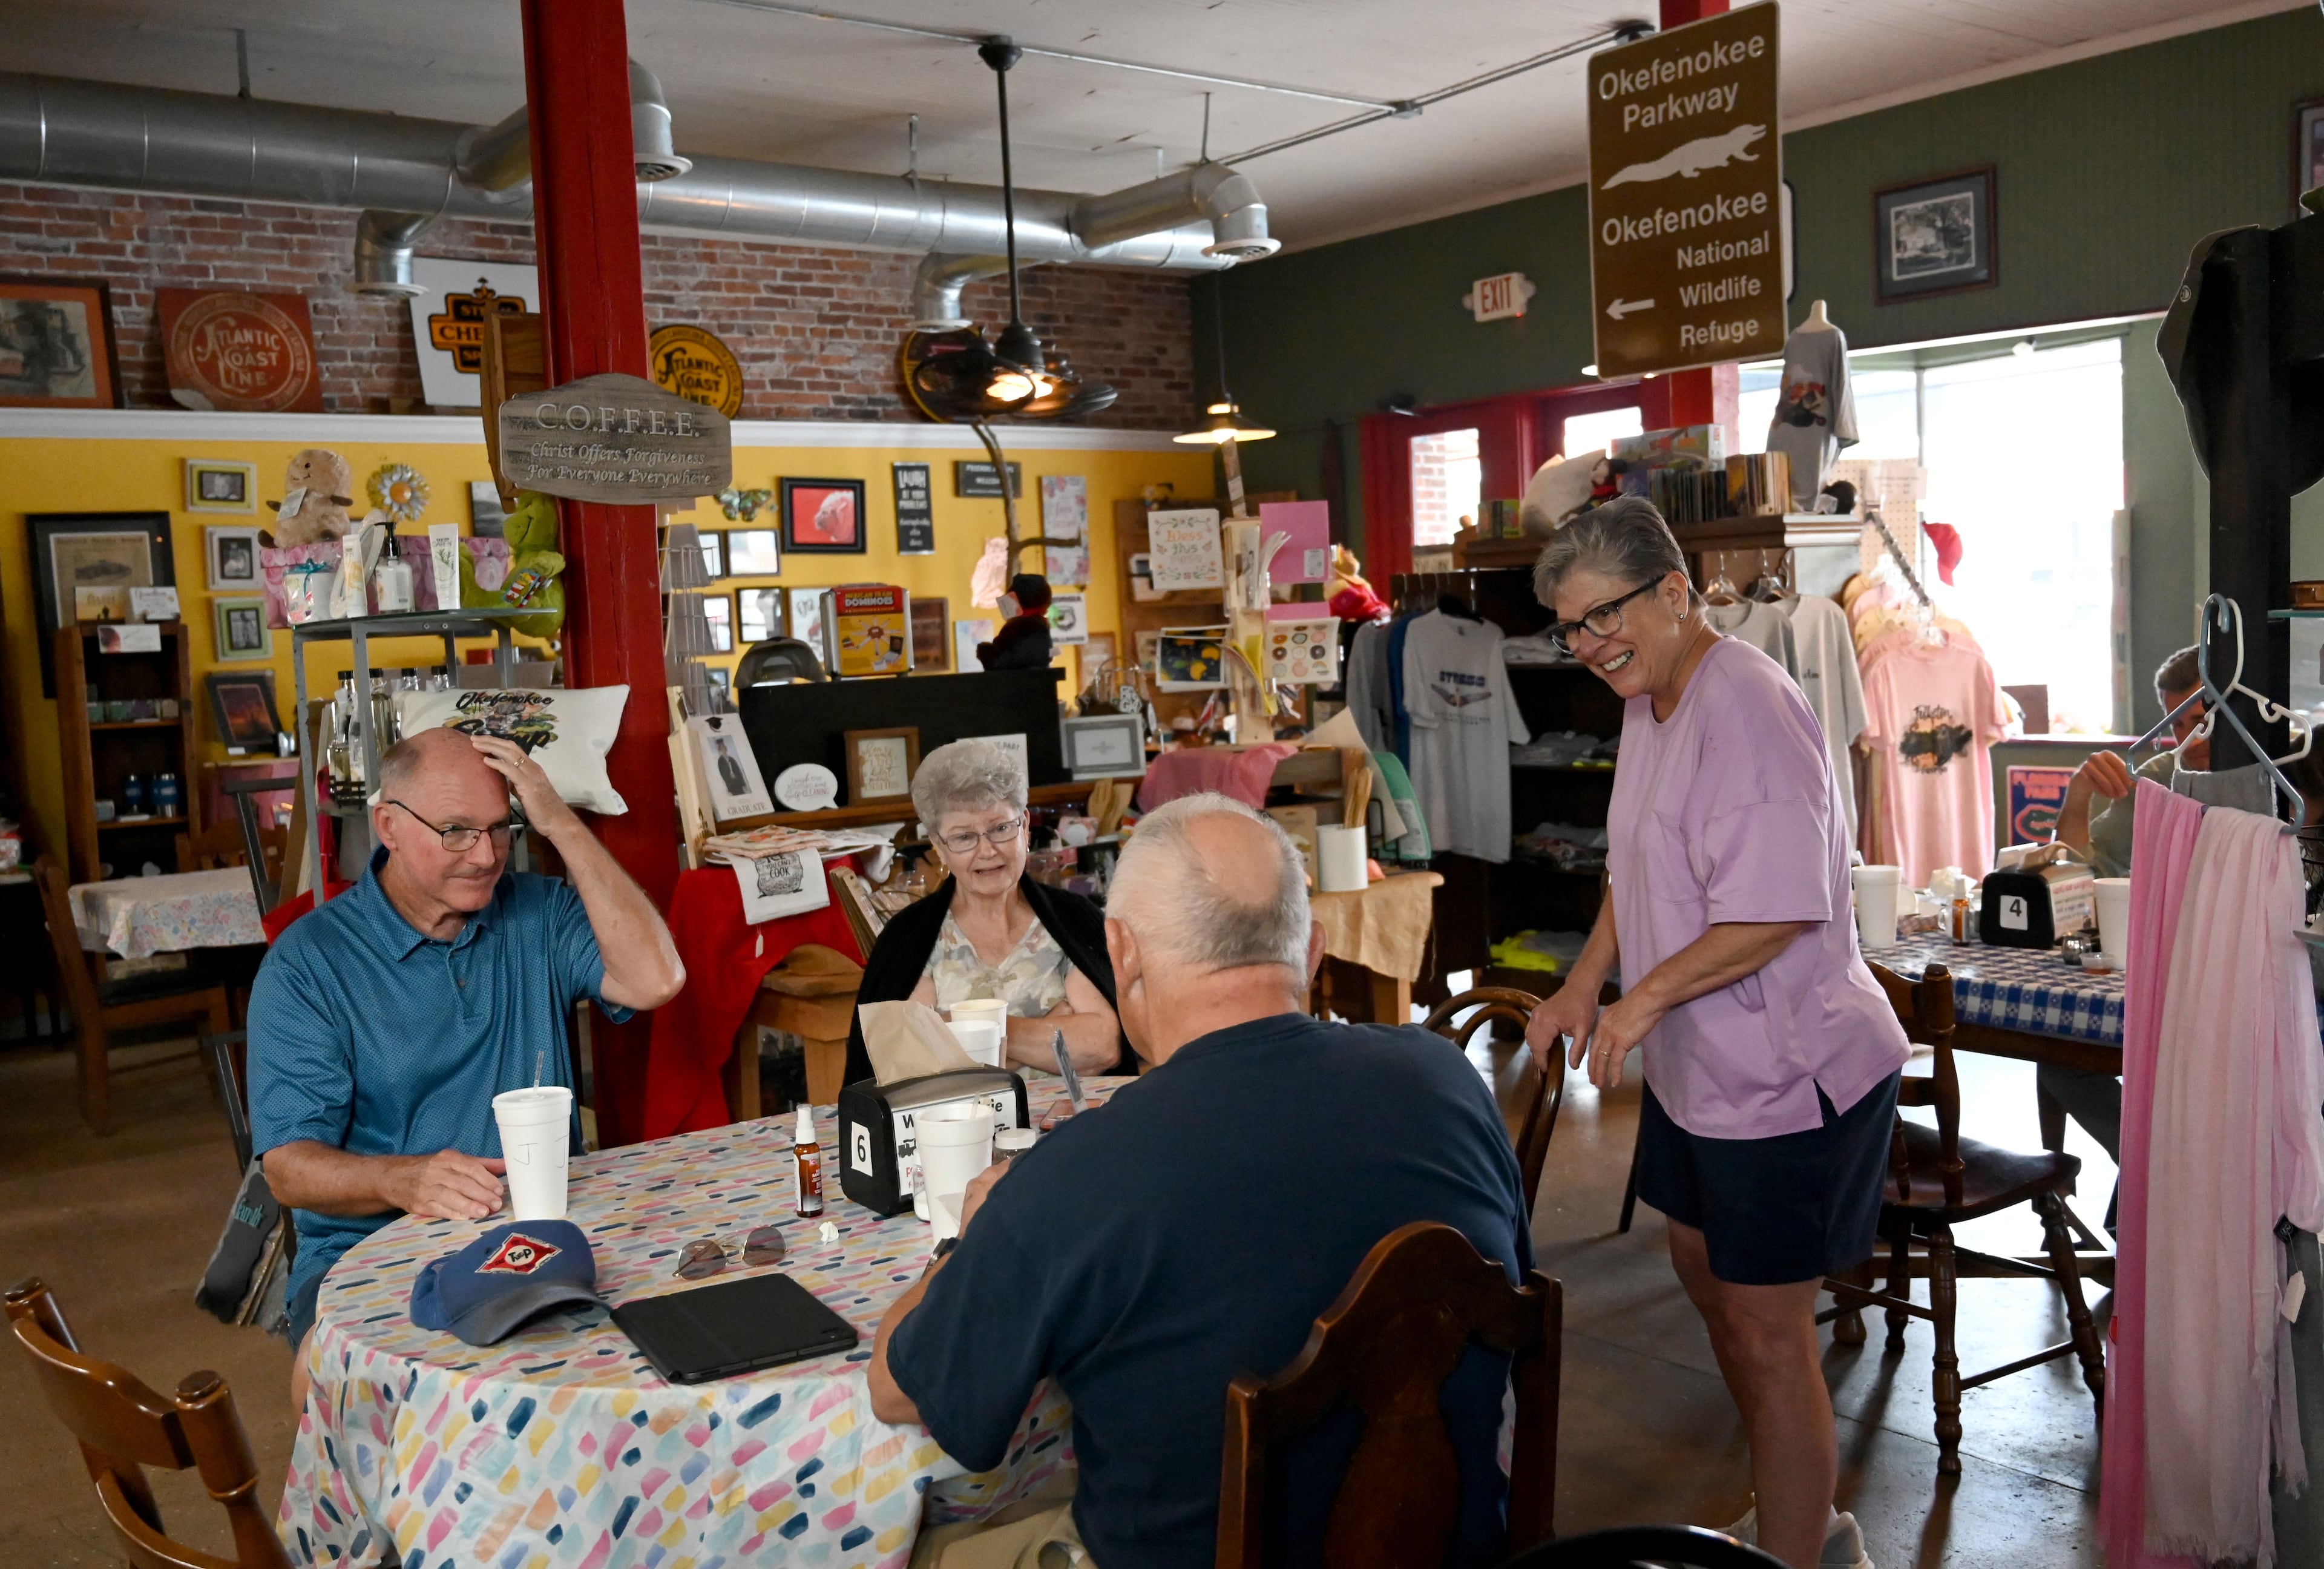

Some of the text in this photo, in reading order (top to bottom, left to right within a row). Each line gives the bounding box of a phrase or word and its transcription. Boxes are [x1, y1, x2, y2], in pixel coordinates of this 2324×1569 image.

[1598, 35, 1765, 100] Okefenokee
[1624, 82, 1738, 133] Parkway
[1602, 191, 1768, 246] Okefenokee
[1676, 230, 1770, 270] National
[1481, 275, 1511, 314] EXIT
[1679, 275, 1761, 308] Wildlife
[197, 317, 281, 361] ATLANTIC
[1680, 318, 1759, 347] Refuge
[224, 347, 279, 373] COAST
[658, 347, 723, 384] ATLANTIC
[218, 358, 268, 393] LINE
[680, 370, 720, 392] COAST
[536, 403, 700, 438] C.O.F.F.E.E.
[531, 442, 705, 466] Christ Offers Forgiveness
[525, 465, 711, 488] For Everyone Everywhere
[1166, 530, 1204, 542] Bless
[844, 596, 893, 607] DOMINOES
[456, 691, 554, 710] Okefenokee
[727, 802, 767, 816] GRADUATE
[769, 867, 790, 879] COOK
[2009, 899, 2022, 917] 4
[857, 1134, 866, 1163] 6
